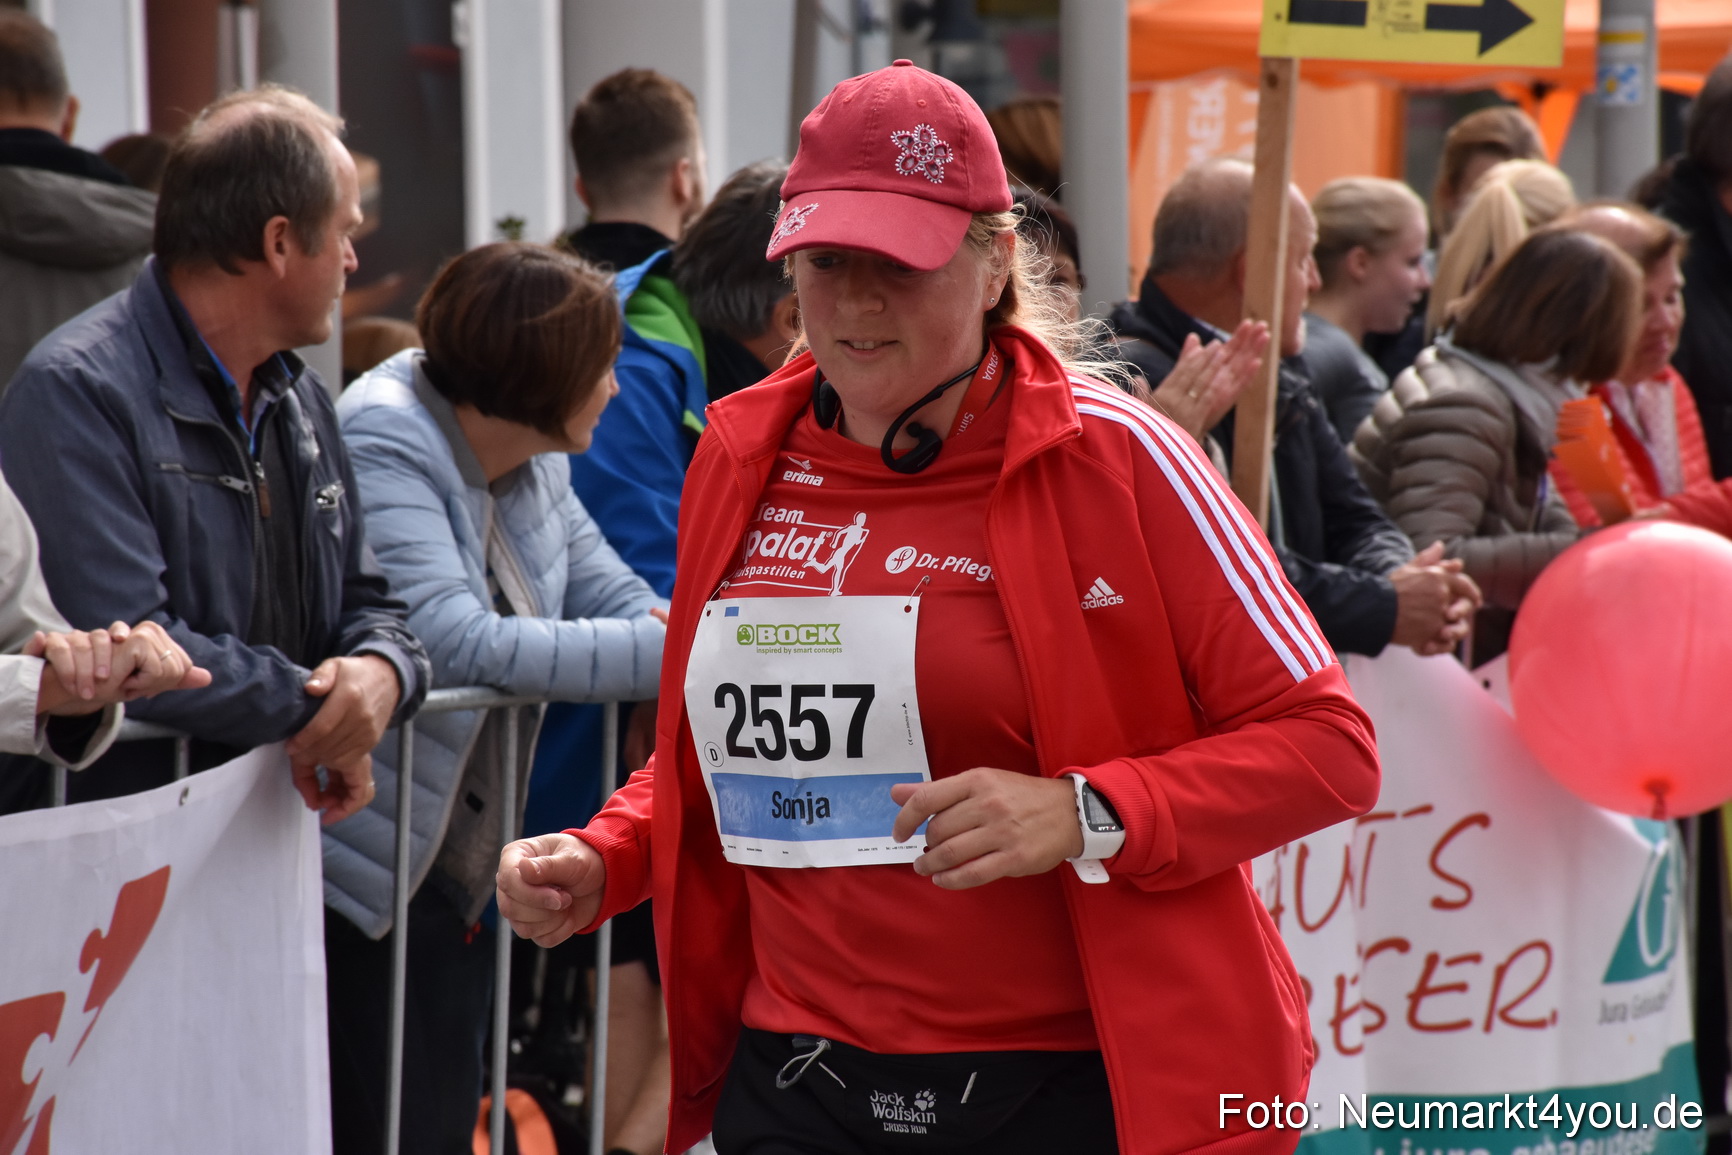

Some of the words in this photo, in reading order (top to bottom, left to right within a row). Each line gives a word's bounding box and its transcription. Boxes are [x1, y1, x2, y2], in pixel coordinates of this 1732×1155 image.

[782, 470, 824, 487] erima
[758, 502, 804, 524] Team
[743, 527, 827, 564] palat
[915, 553, 938, 570] Dr.
[941, 555, 996, 582] Pfleg
[1081, 595, 1124, 610] adidas
[756, 624, 841, 645] BOCK
[756, 647, 782, 655] inspired
[783, 647, 792, 655] by
[814, 647, 843, 655] concepts
[714, 682, 876, 762] 2557
[709, 748, 719, 761] D
[771, 790, 831, 825] Sonja
[869, 1089, 906, 1107] Jack
[870, 1101, 937, 1124] Wolfskin
[883, 1122, 910, 1133] CROSS
[910, 1124, 928, 1135] RUN
